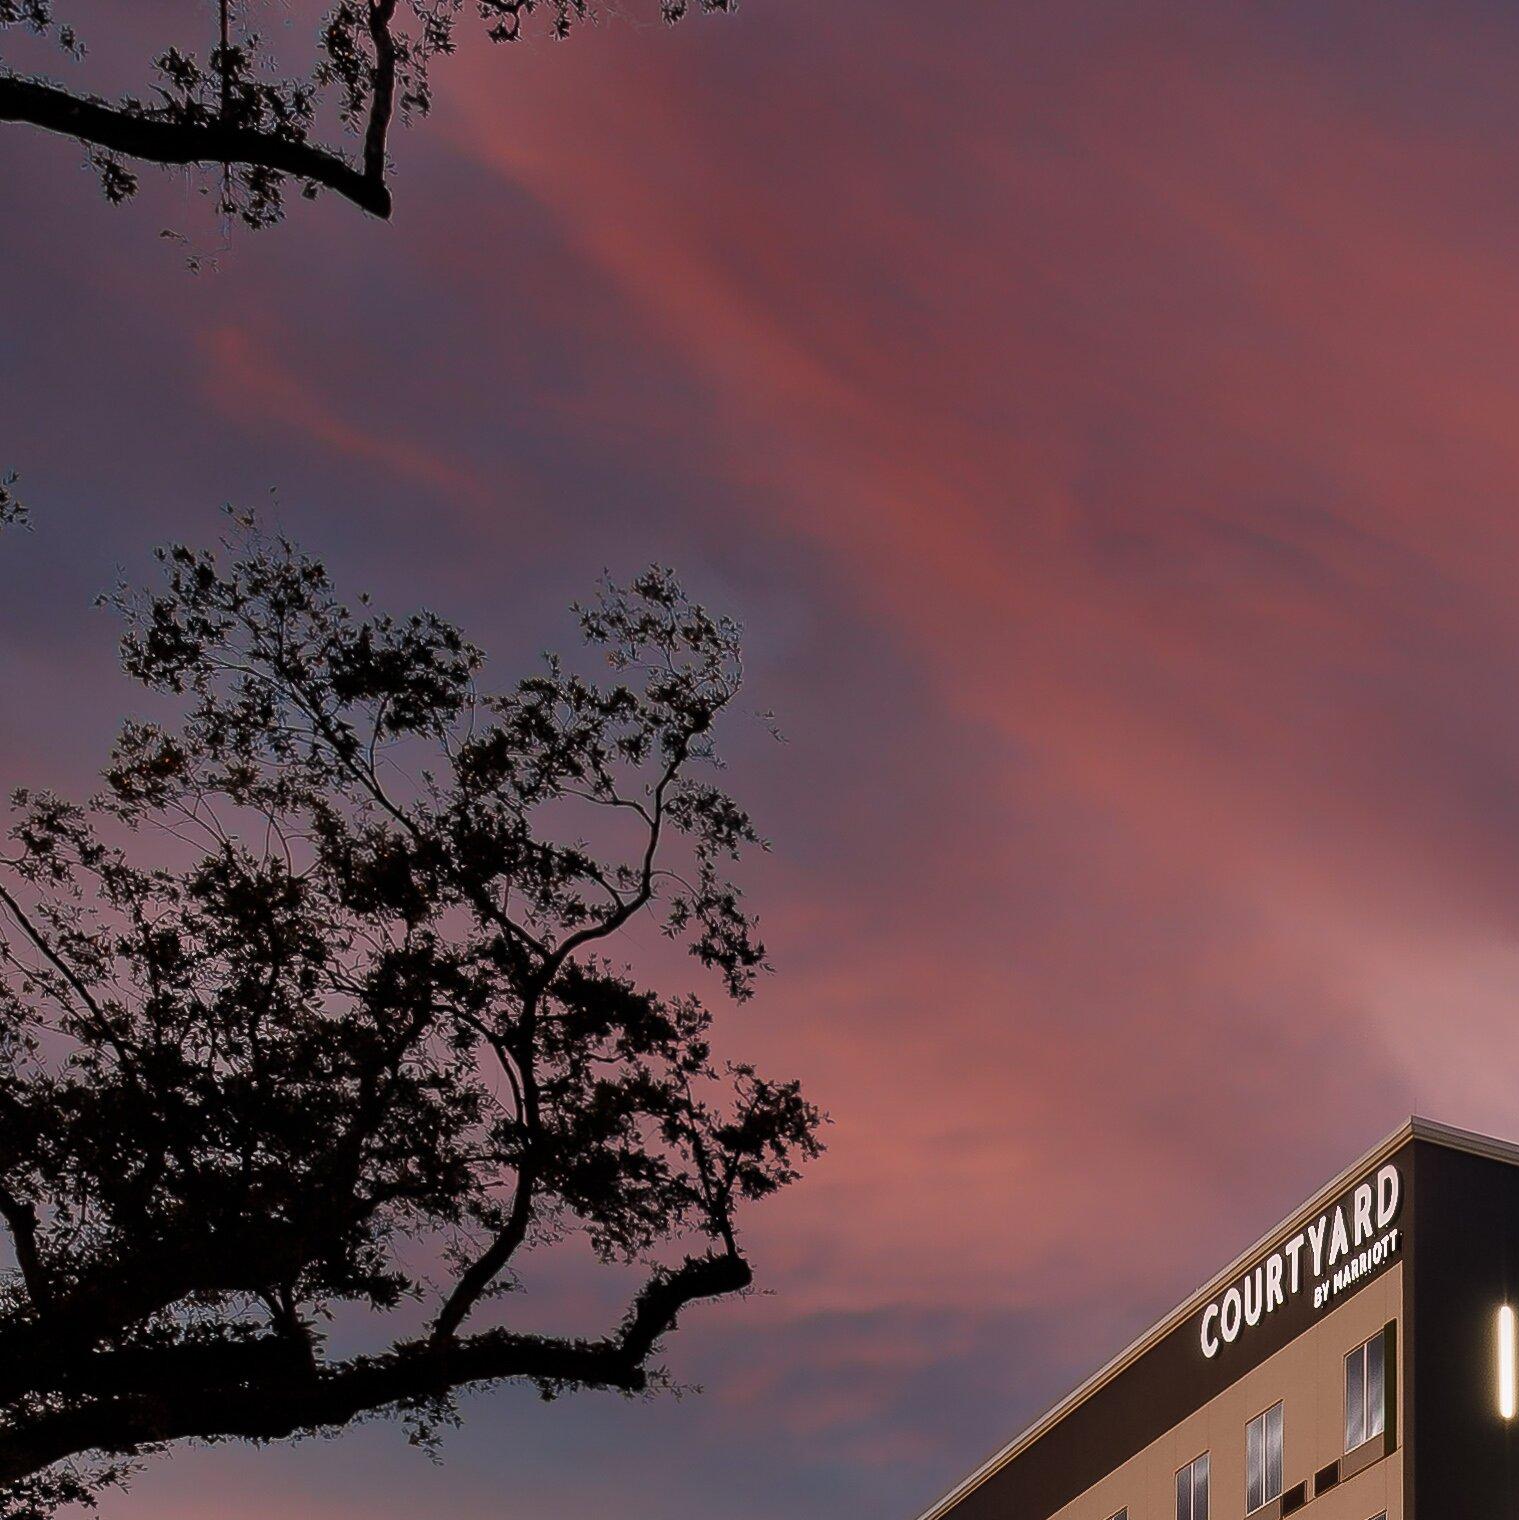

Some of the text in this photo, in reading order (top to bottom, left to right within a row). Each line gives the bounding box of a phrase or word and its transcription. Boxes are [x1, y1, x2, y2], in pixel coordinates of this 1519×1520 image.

[1200, 1163, 1400, 1359] COURTYARD
[1313, 1228, 1398, 1309] BY MARRIOTT
